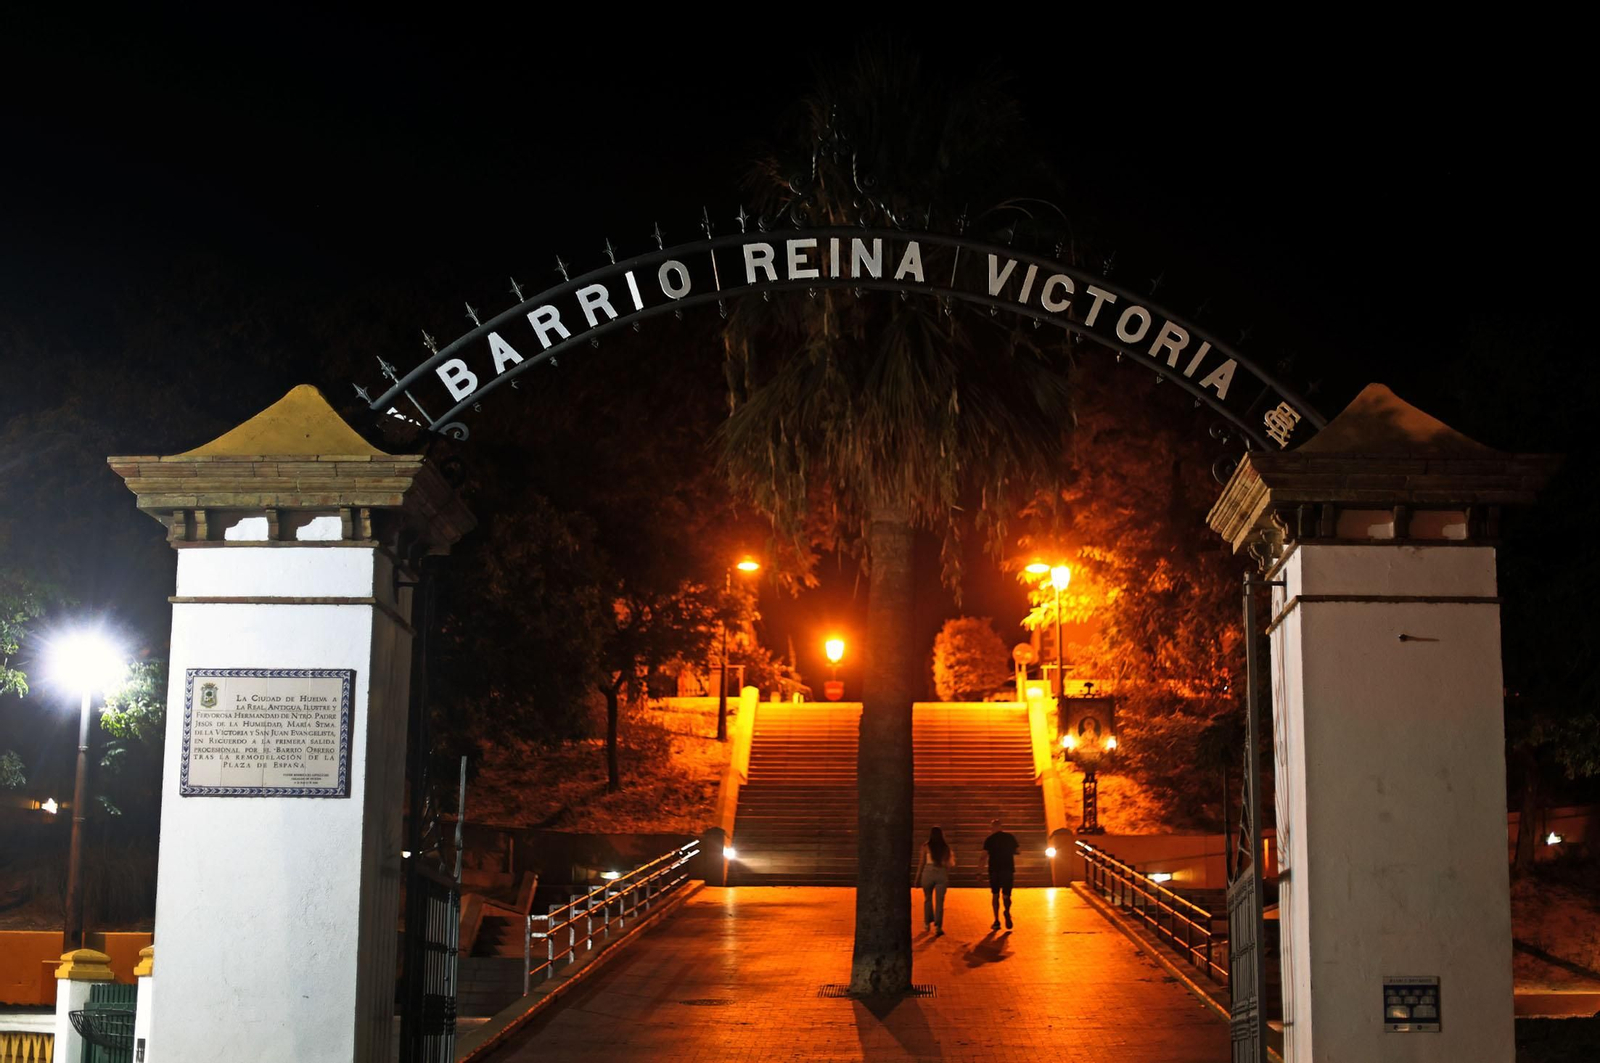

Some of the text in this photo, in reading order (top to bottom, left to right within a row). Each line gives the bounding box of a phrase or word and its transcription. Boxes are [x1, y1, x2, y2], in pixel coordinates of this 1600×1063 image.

[435, 237, 1238, 403] BARRIO REINA VICTORIA
